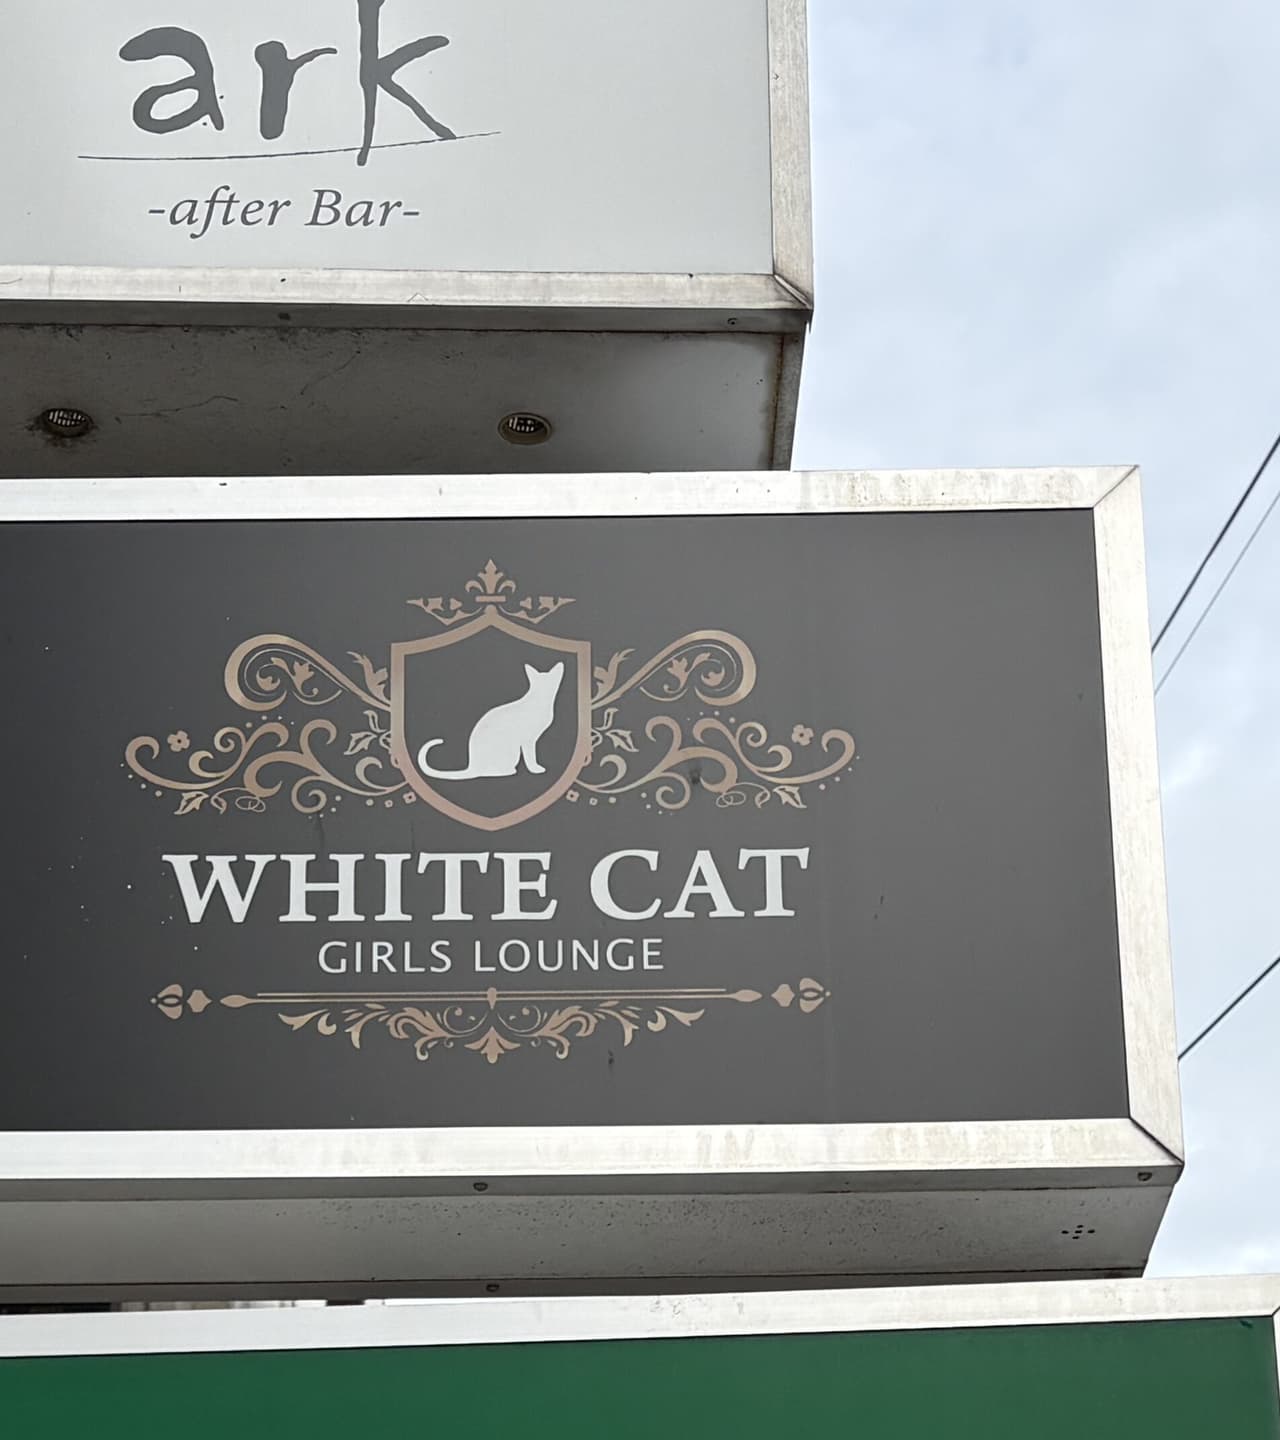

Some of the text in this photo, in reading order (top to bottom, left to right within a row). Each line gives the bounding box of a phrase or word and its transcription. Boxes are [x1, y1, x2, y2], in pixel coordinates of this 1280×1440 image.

[119, 0, 464, 167] ark
[148, 185, 420, 240] -after Bar-
[161, 846, 810, 923] WHITE CAT
[318, 938, 664, 974] GIRLS LOUNGE
